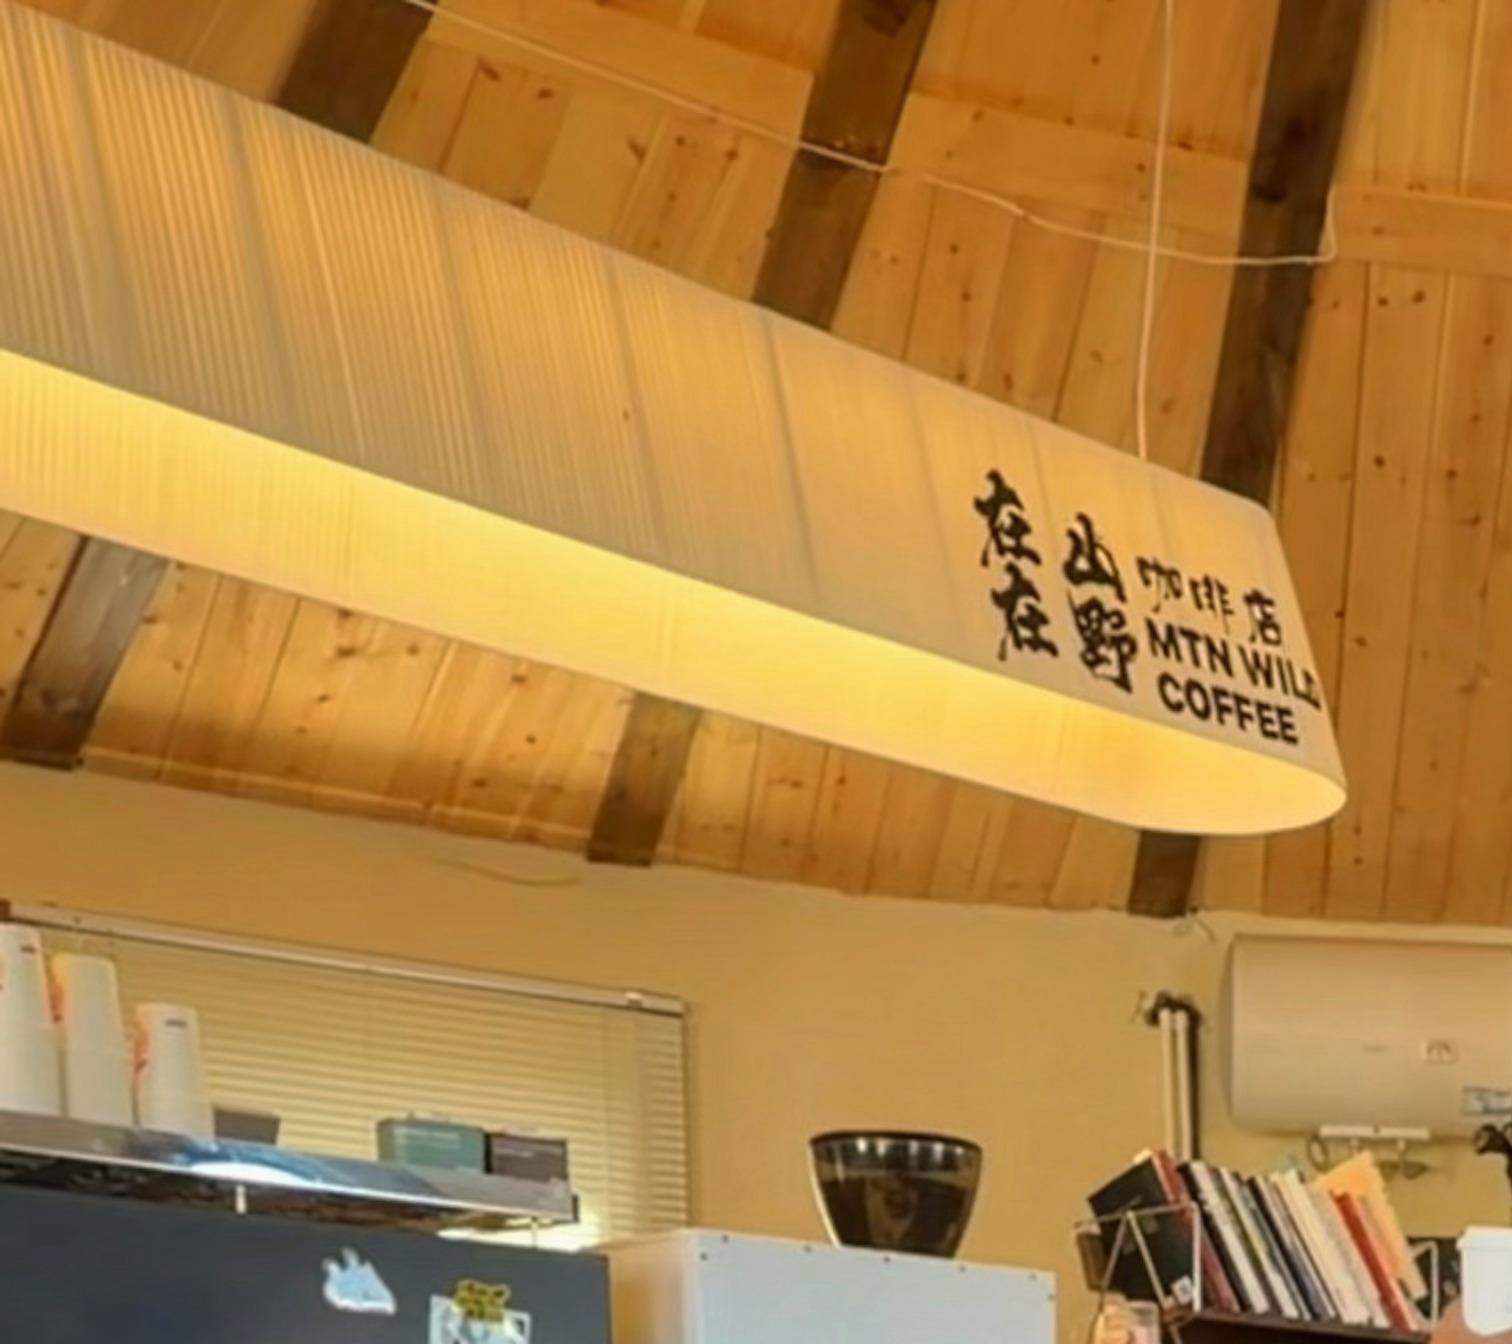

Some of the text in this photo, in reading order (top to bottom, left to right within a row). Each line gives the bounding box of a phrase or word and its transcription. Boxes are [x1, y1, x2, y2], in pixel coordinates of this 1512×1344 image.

[1136, 556, 1282, 646] 咖啡店
[1145, 617, 1234, 678] MTN
[1158, 671, 1299, 746] COFFEE
